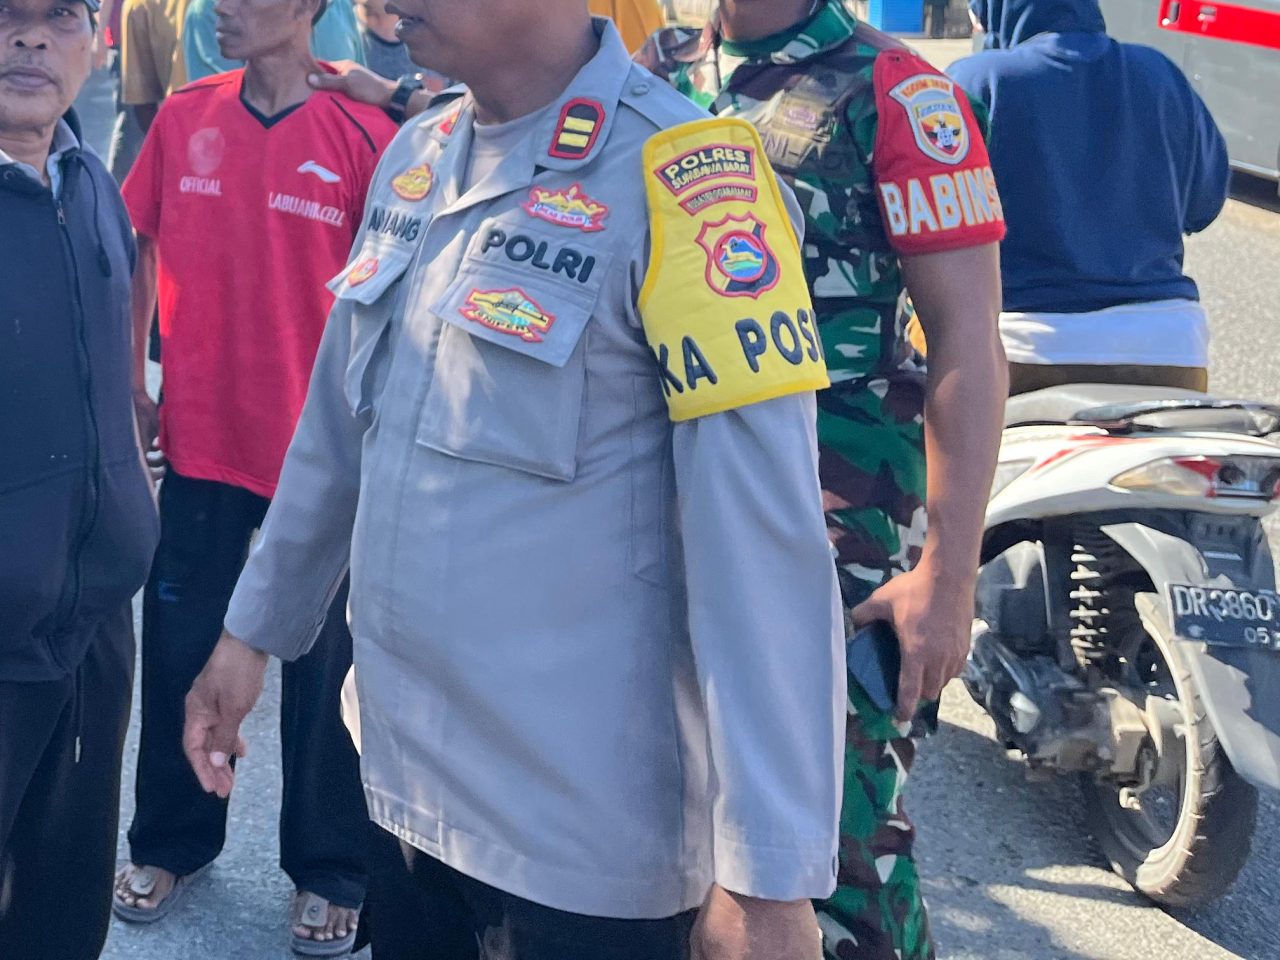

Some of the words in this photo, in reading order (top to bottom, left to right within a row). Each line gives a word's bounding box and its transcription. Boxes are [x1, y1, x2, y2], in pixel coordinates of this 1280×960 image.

[664, 147, 747, 181] POLRES
[180, 176, 223, 196] OFFICIAL
[481, 229, 596, 284] POLRI
[649, 335, 718, 397] KA
[734, 308, 825, 373] POS
[1172, 585, 1210, 616] DR
[1243, 626, 1270, 644] 05
